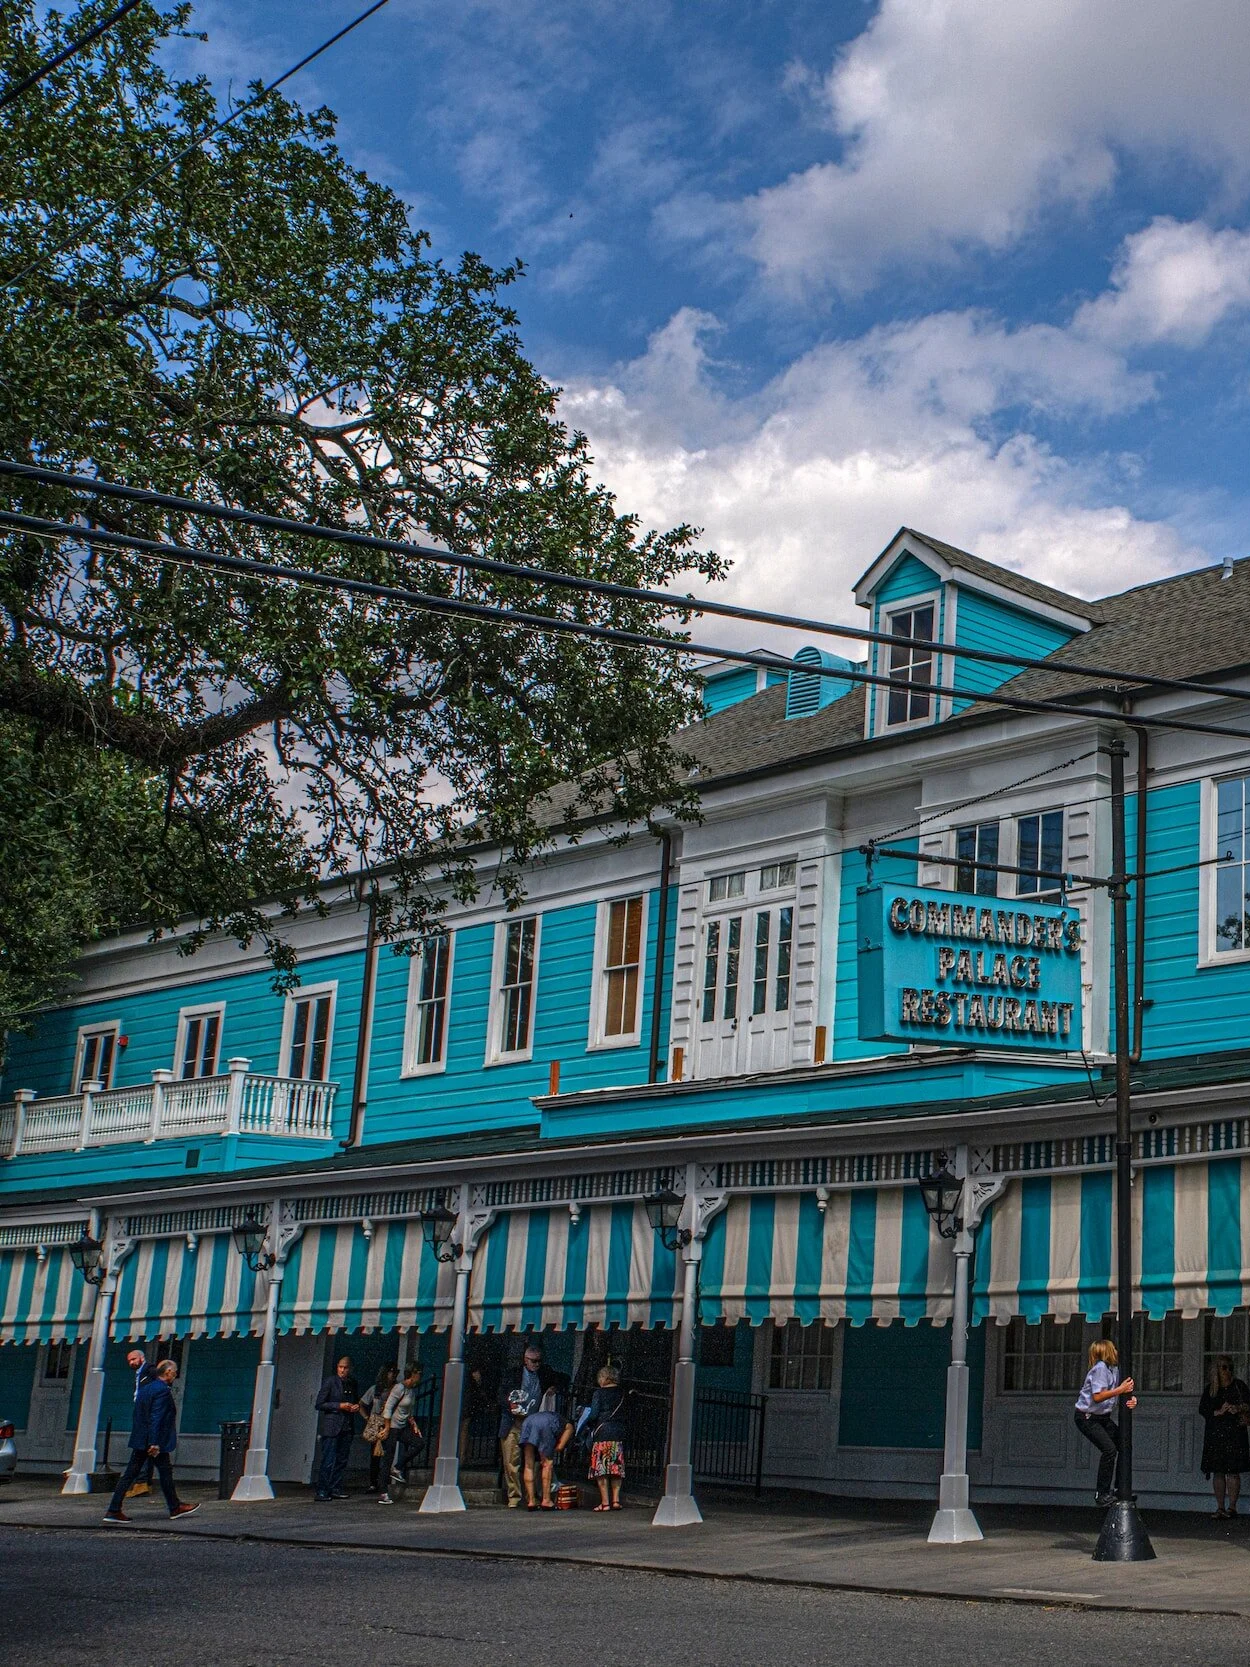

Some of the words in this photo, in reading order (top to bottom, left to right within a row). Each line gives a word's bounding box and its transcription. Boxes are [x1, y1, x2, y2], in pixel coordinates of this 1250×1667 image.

[891, 897, 1081, 951] COMMANDER'S
[938, 947, 1041, 988] PALACE
[902, 988, 1074, 1034] RESTAURANT
